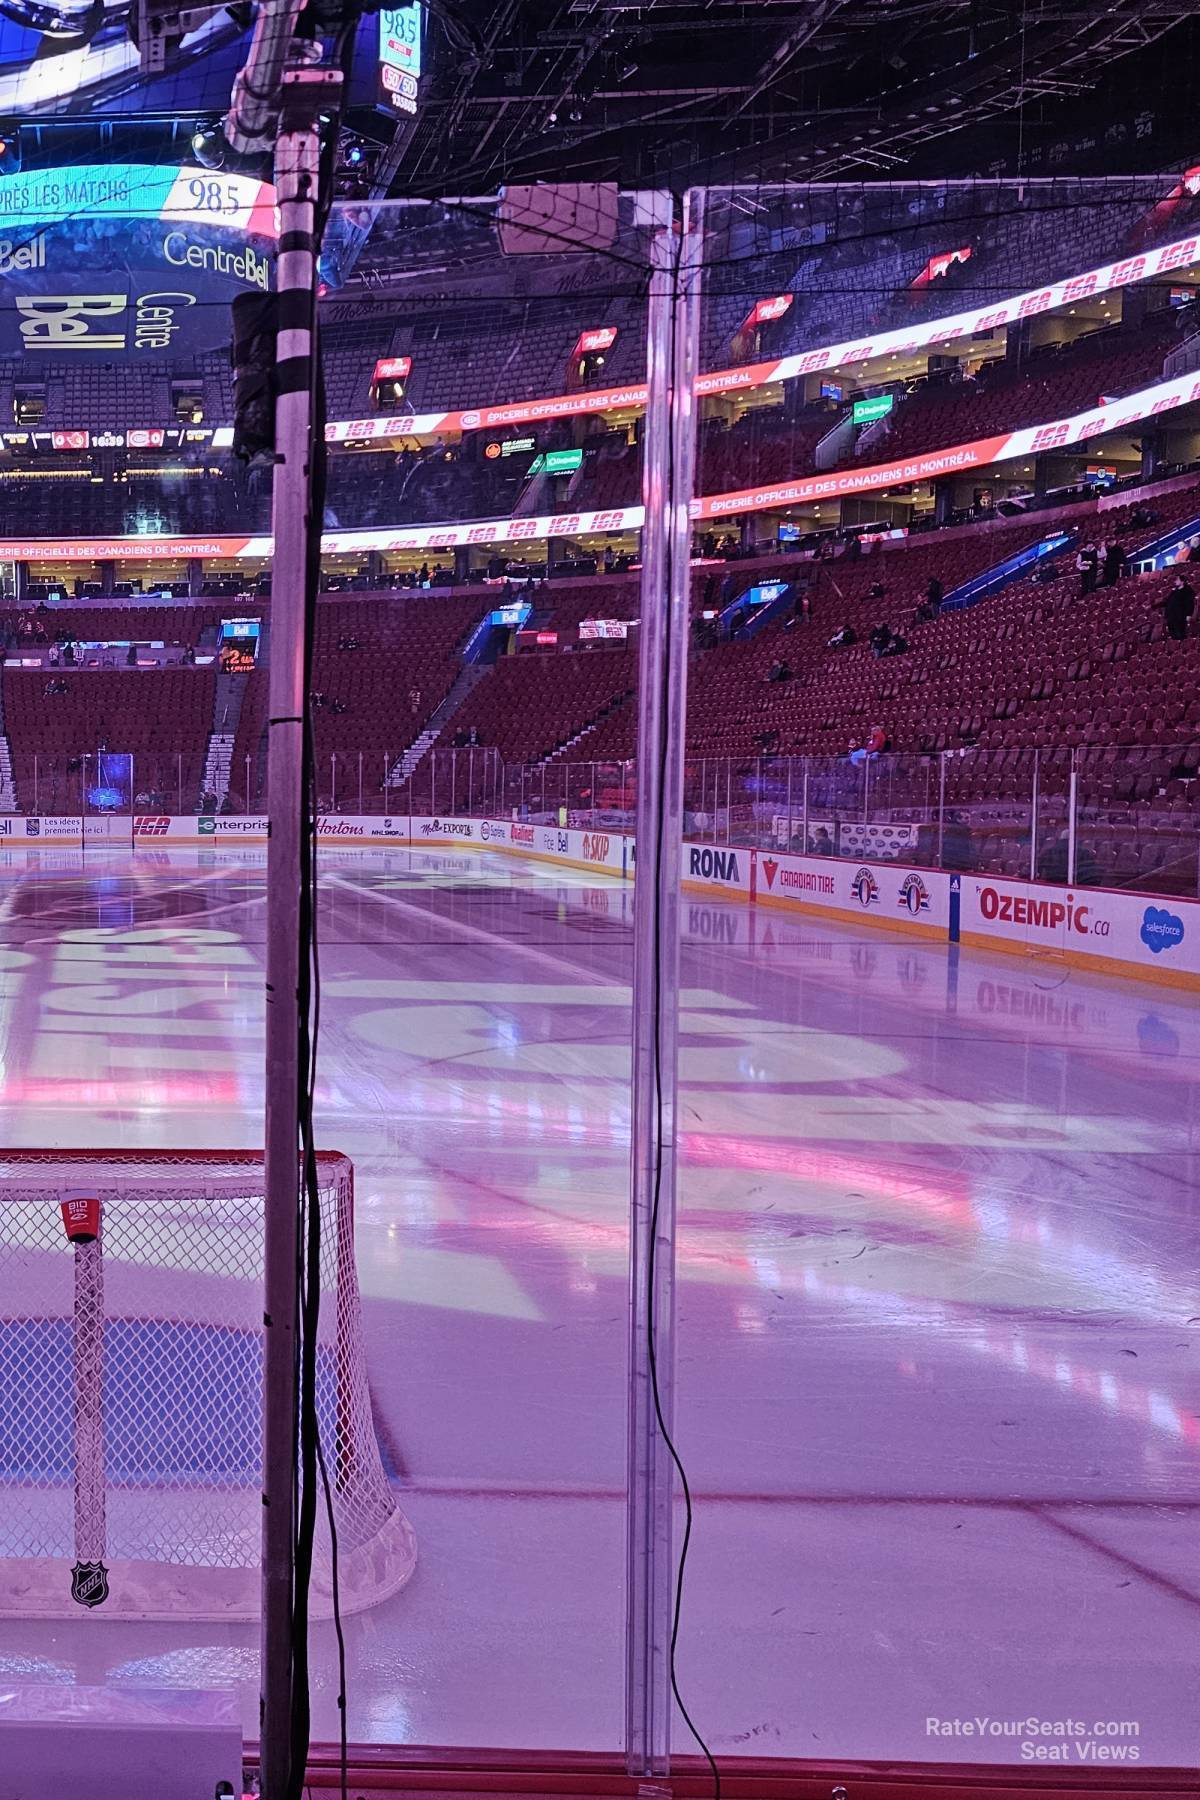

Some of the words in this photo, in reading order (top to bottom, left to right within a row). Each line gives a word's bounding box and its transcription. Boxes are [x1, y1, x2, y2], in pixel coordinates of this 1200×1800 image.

[384, 11, 416, 43] 98.5
[34, 184, 60, 207] LES
[65, 179, 128, 203] MATCHS
[189, 179, 240, 216] 98.5
[1017, 291, 1052, 318] IGA
[1062, 274, 1098, 301] IGA
[1108, 257, 1147, 288] IGA
[1156, 240, 1198, 271] IGA
[15, 294, 128, 350] Bell
[797, 351, 831, 374] IGA
[487, 405, 530, 422] ÉPICERIE
[531, 399, 587, 416] OFFICIELLE
[589, 395, 608, 407] DES
[345, 422, 376, 438] IGA
[383, 418, 415, 434] IGA
[1031, 423, 1071, 450] IGA
[710, 495, 754, 512] ÉPICERIE
[755, 486, 814, 503] OFFICIELLE
[815, 480, 837, 494] DES
[839, 469, 903, 489] CANADIENS
[904, 464, 918, 477] DE
[919, 451, 978, 473] MONTRÉAL
[466, 528, 497, 542] IGA
[506, 521, 537, 538] IGA
[547, 516, 580, 533] IGA
[590, 511, 624, 530] IGA
[22, 545, 76, 556] OFFICIELLE
[77, 545, 97, 556] DES
[98, 545, 153, 556] CANADIENS
[154, 545, 168, 555] DE
[170, 543, 223, 555] MONTRÉAL
[760, 587, 777, 600] Bell
[503, 612, 519, 623] Bell
[234, 625, 249, 635] Bell
[44, 818, 57, 826] Les
[59, 818, 80, 826] idées
[44, 827, 79, 837] prennent
[81, 826, 92, 834] vie
[94, 826, 103, 834] ici
[133, 817, 171, 835] IGA
[200, 819, 270, 831] enterpris
[315, 818, 364, 836] Hortons
[558, 832, 568, 852] Bell
[590, 836, 609, 862] SKIP
[690, 848, 741, 883] RONA
[780, 870, 817, 891] CANADIAN
[818, 875, 835, 894] TIRE
[1146, 922, 1181, 938] salesforce
[80, 1575, 101, 1597] NHL
